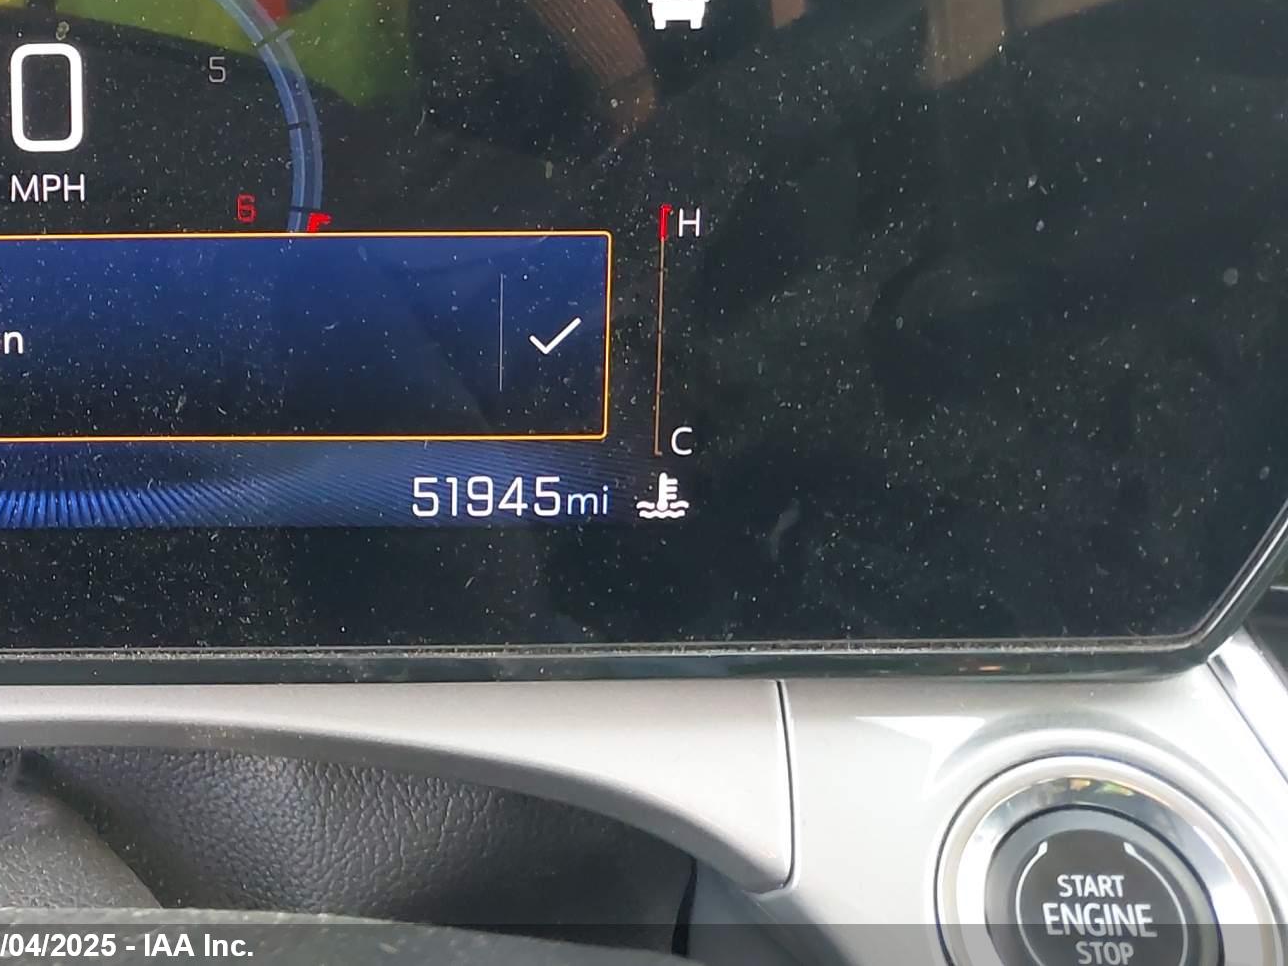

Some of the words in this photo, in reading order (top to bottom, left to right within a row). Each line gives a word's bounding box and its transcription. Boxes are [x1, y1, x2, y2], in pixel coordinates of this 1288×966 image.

[208, 56, 227, 84] 5
[9, 42, 85, 153] 0
[10, 173, 86, 203] MPH
[236, 194, 257, 224] 6
[678, 209, 701, 238] H
[670, 427, 693, 457] C
[1056, 874, 1125, 898] START
[1041, 902, 1156, 938] ENGINE
[1075, 941, 1134, 966] STOP
